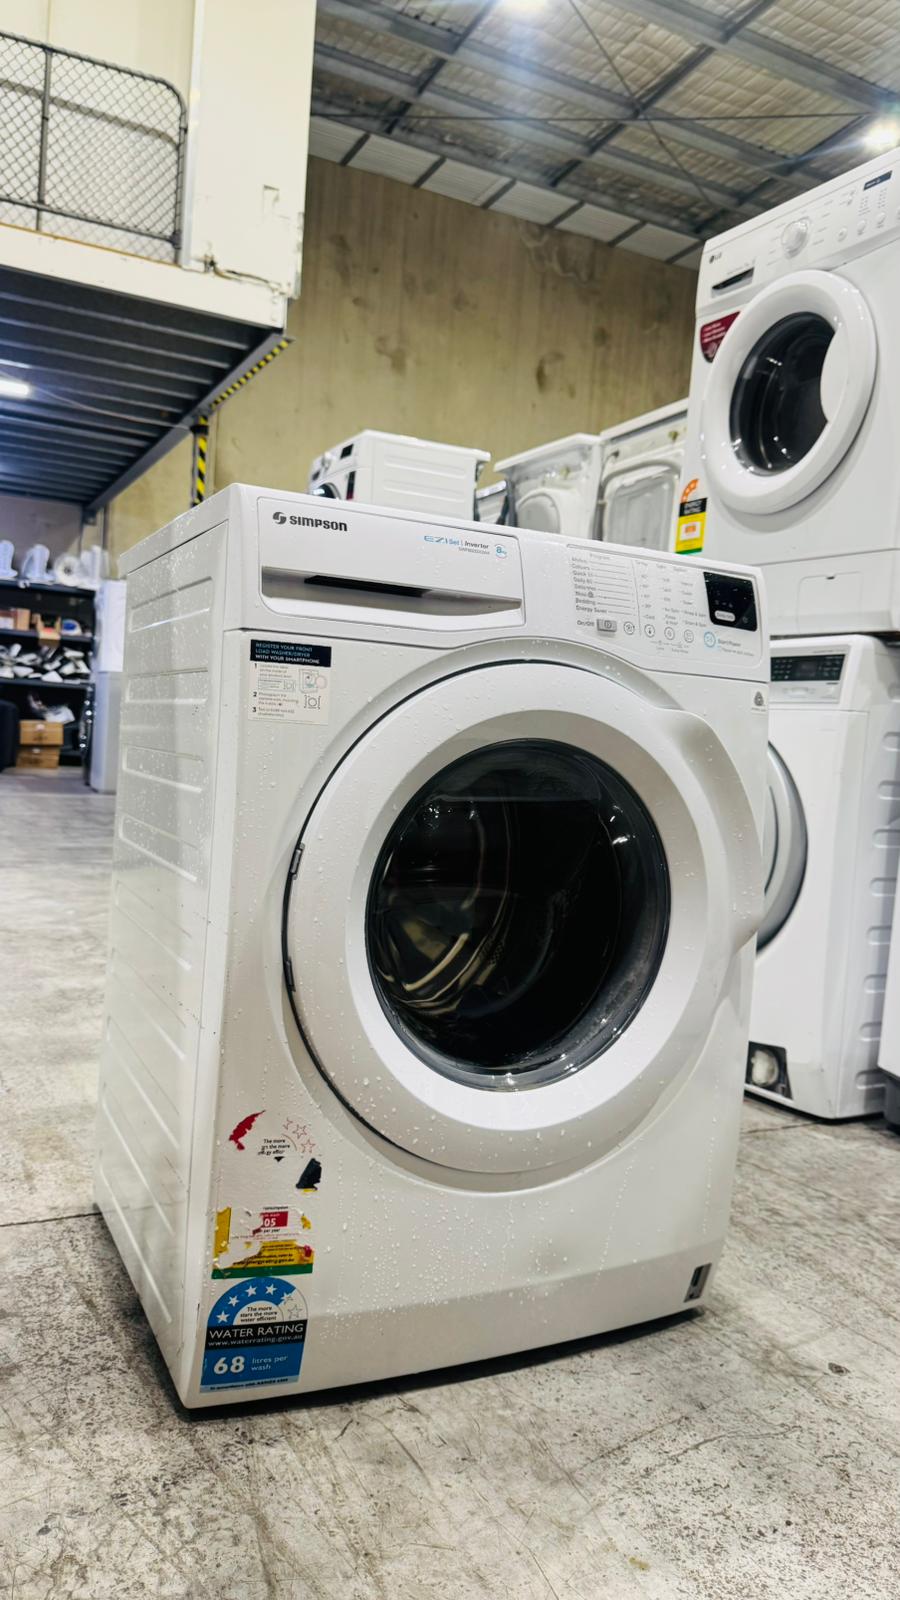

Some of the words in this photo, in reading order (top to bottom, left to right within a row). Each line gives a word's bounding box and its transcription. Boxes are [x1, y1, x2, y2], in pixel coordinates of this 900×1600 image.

[289, 515, 348, 531] SIMPSON
[464, 540, 489, 549] Inverter
[209, 1328, 254, 1339] WATER
[257, 1323, 304, 1336] RATING
[208, 1335, 303, 1347] www.waterrating.gov.au
[213, 1355, 245, 1375] 68
[274, 1355, 288, 1364] per
[251, 1364, 271, 1372] wash
